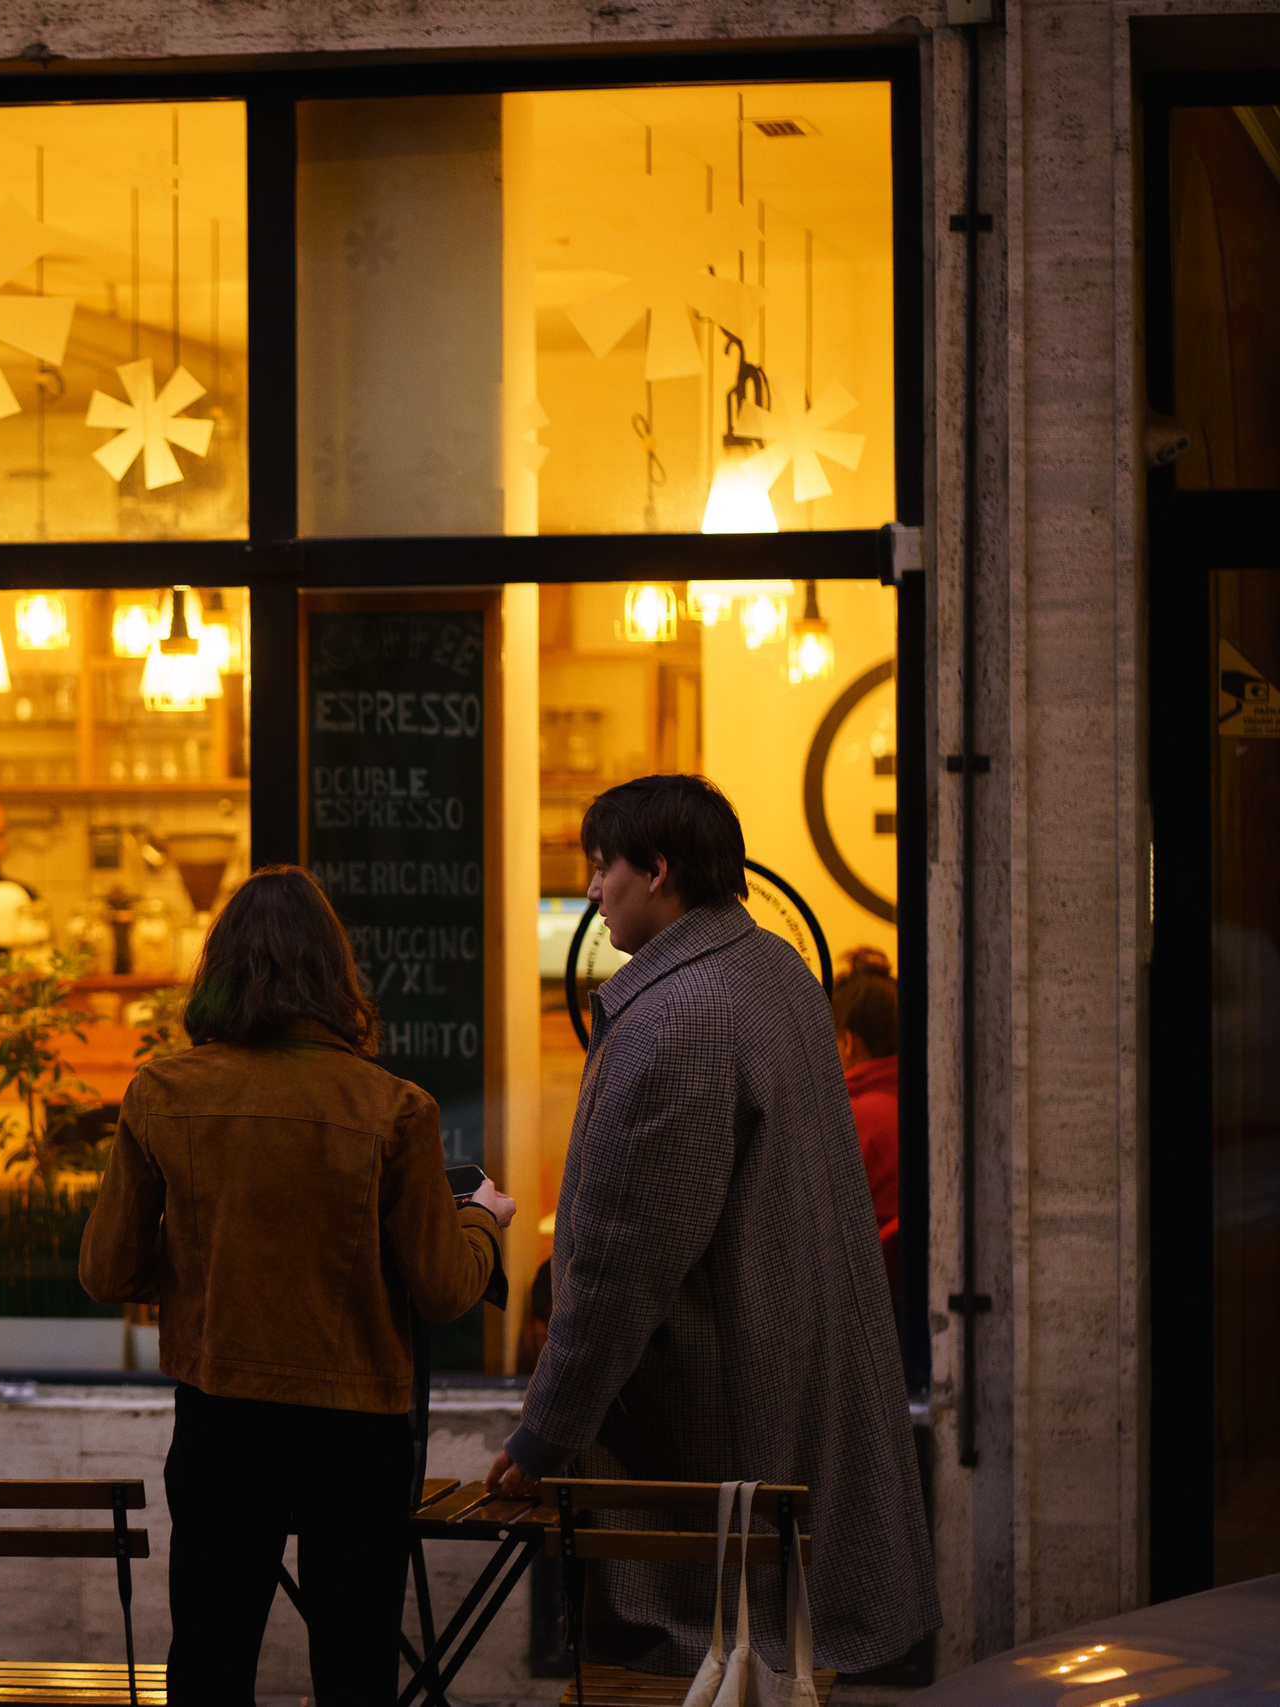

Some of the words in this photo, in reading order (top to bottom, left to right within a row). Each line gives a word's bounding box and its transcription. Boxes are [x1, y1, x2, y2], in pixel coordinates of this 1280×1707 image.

[315, 690, 480, 738] ESPRESSO
[313, 766, 430, 798] DOUBLE
[315, 797, 464, 831] ESPRESSO
